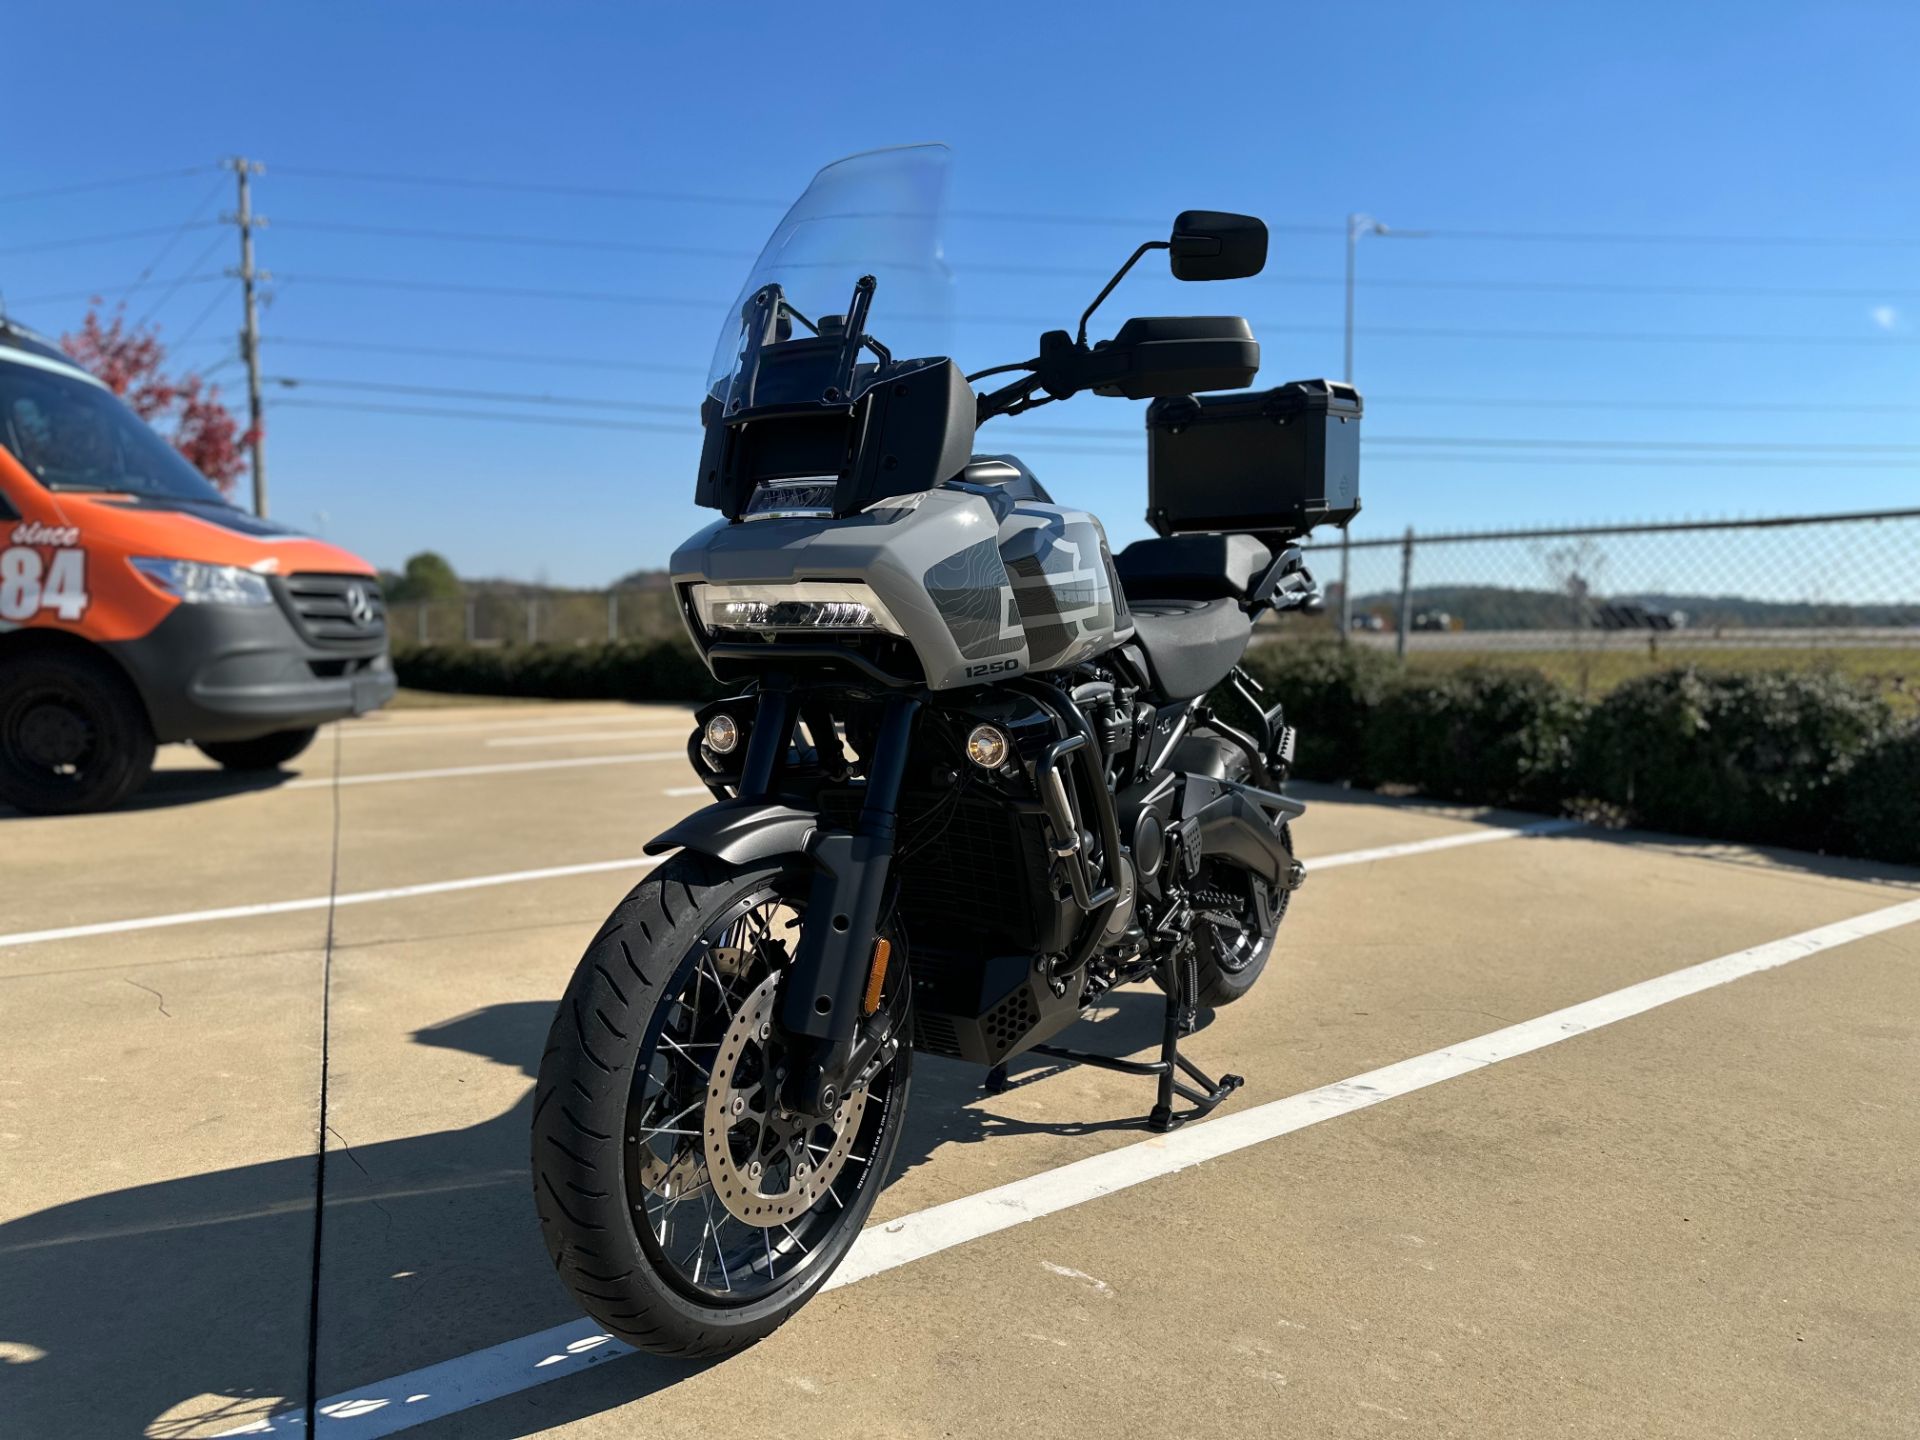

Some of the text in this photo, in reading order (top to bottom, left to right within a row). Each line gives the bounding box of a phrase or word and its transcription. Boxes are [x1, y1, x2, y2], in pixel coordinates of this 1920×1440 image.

[11, 521, 80, 546] since
[0, 546, 88, 619] 84
[965, 658, 1019, 678] 1250
